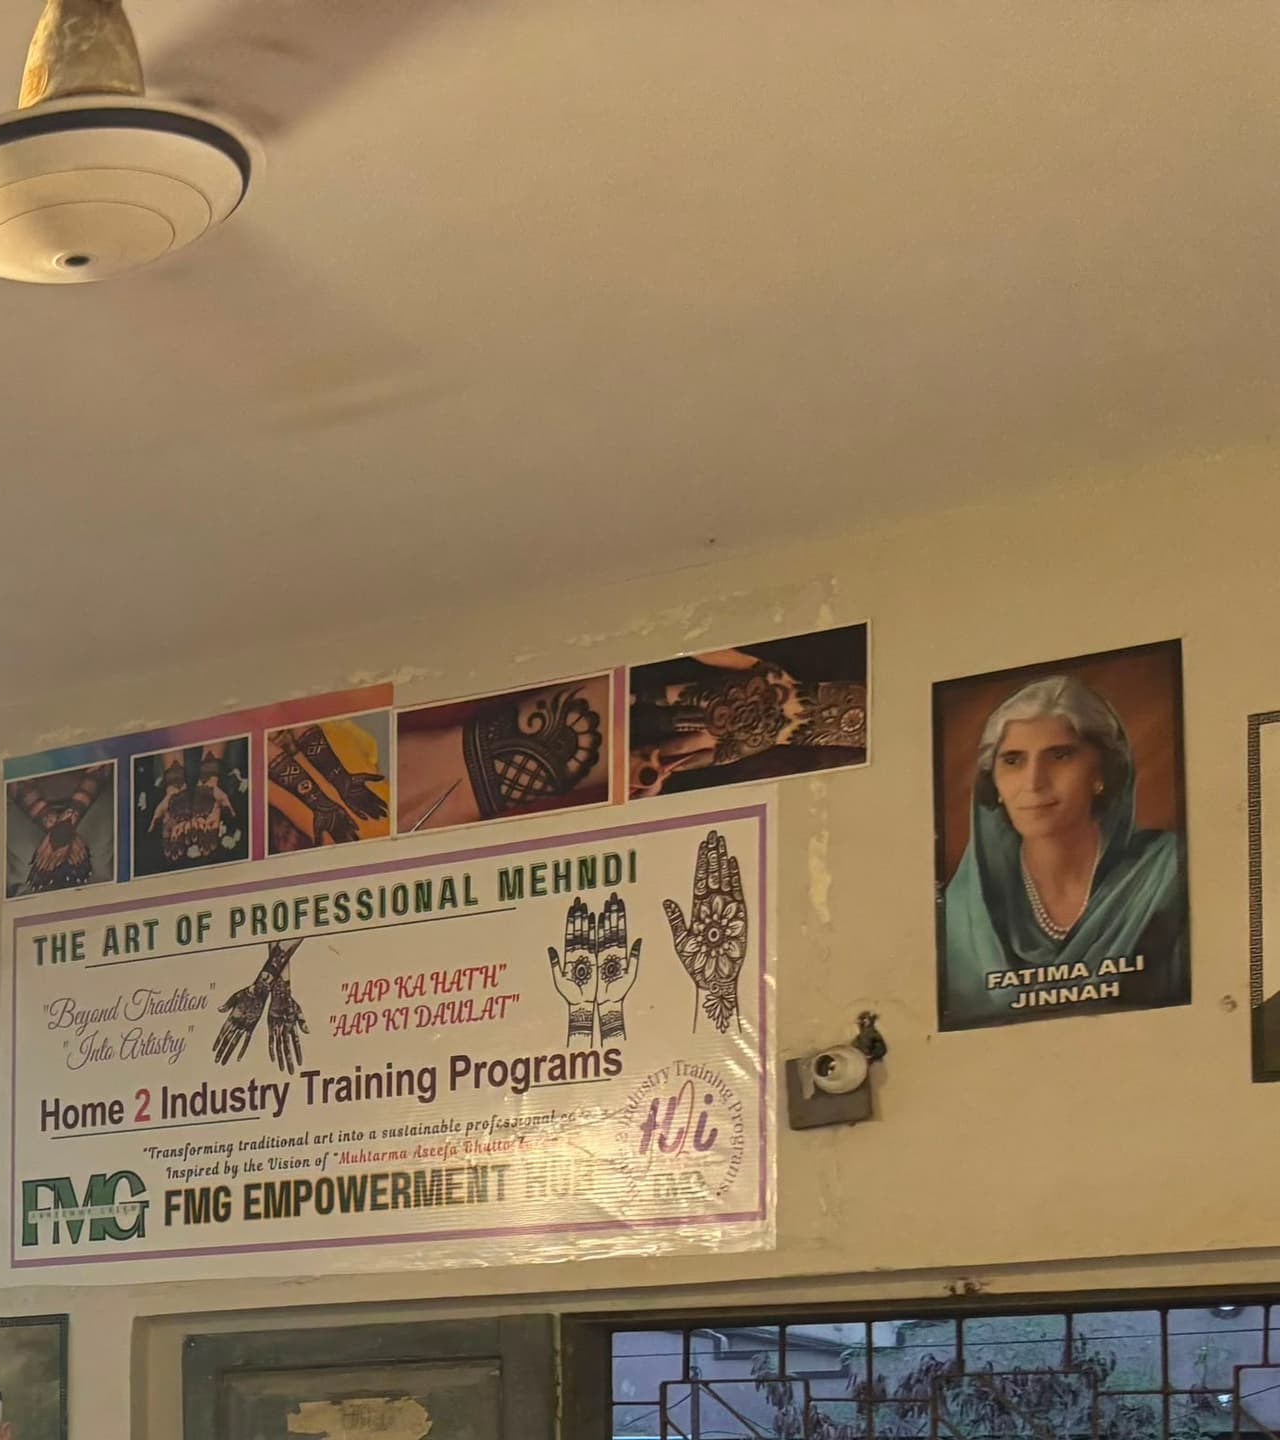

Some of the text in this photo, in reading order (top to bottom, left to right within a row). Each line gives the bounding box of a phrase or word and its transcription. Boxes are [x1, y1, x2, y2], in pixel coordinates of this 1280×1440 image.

[32, 848, 637, 966] THE ART OF PROFESSIONAL MEHNDI
[987, 954, 1145, 989] FATIMA ALI
[1010, 982, 1120, 1009] JINNAH
[40, 1048, 623, 1132] Home 2 Industry Training Programs
[238, 1131, 310, 1152] traditional
[313, 1132, 334, 1146] art
[338, 1130, 365, 1143] into
[368, 1130, 378, 1141] a
[381, 1117, 462, 1140] sustainable
[166, 1162, 220, 1183] Inspired
[223, 1159, 240, 1178] by
[243, 1157, 264, 1173] the
[268, 1156, 311, 1171] Vision
[314, 1152, 330, 1171] of
[21, 1168, 150, 1246] FMG
[163, 1185, 232, 1226] FMG
[243, 1164, 510, 1221] EMPOWERMENT
